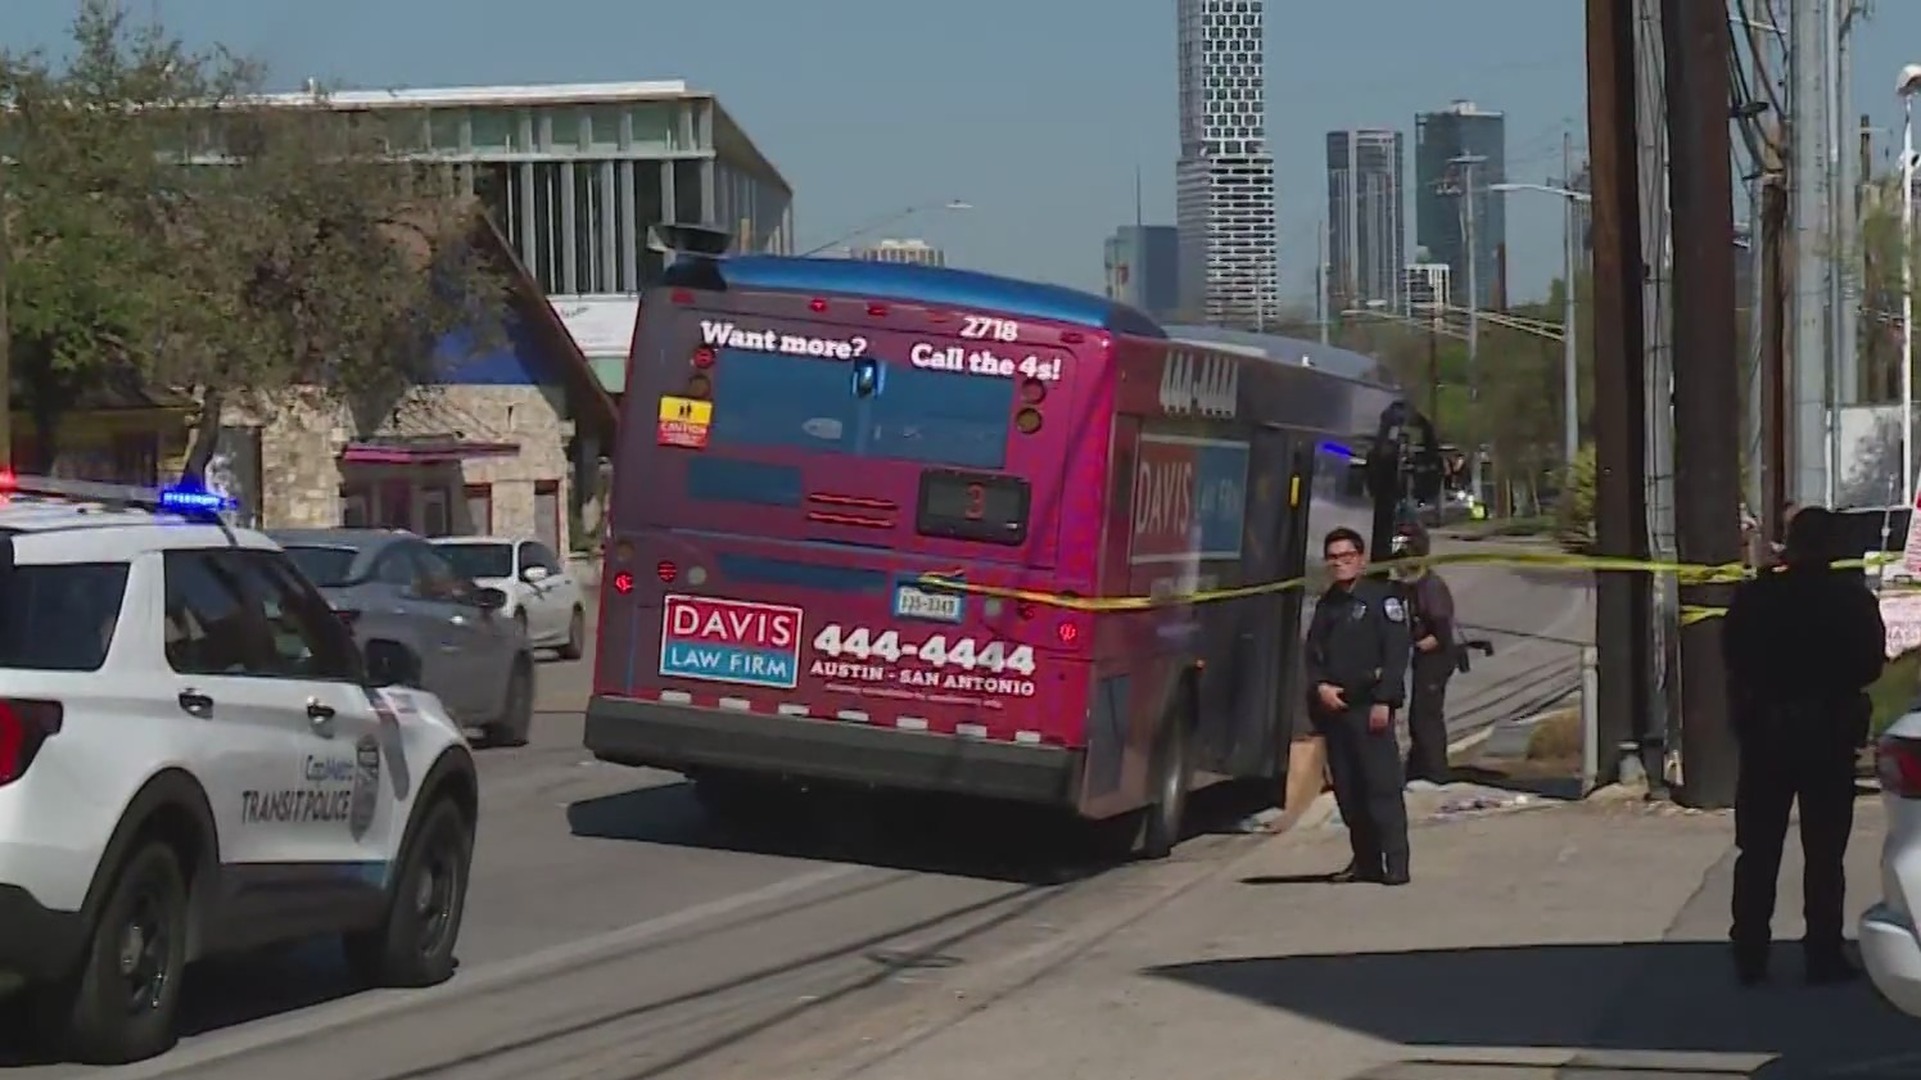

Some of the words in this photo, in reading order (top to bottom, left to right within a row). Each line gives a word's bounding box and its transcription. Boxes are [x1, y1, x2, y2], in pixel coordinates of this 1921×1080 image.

[701, 320, 776, 351] Want
[780, 335, 867, 360] more?
[960, 316, 1018, 342] 2718
[910, 343, 965, 370] Call
[969, 350, 1016, 375] the
[1018, 355, 1061, 381] 4s!
[964, 484, 986, 520] 3
[1136, 461, 1194, 536] DAVIS
[674, 604, 792, 647] DAVIS
[671, 646, 722, 668] LAW
[729, 653, 788, 678] FIRM
[813, 624, 1036, 676] 444-4444
[810, 659, 884, 681] AUSTIN
[900, 669, 940, 687] SAN
[943, 674, 1036, 697] ANTONIO
[242, 789, 305, 824] TRANSIT
[302, 790, 352, 822] POLICE
